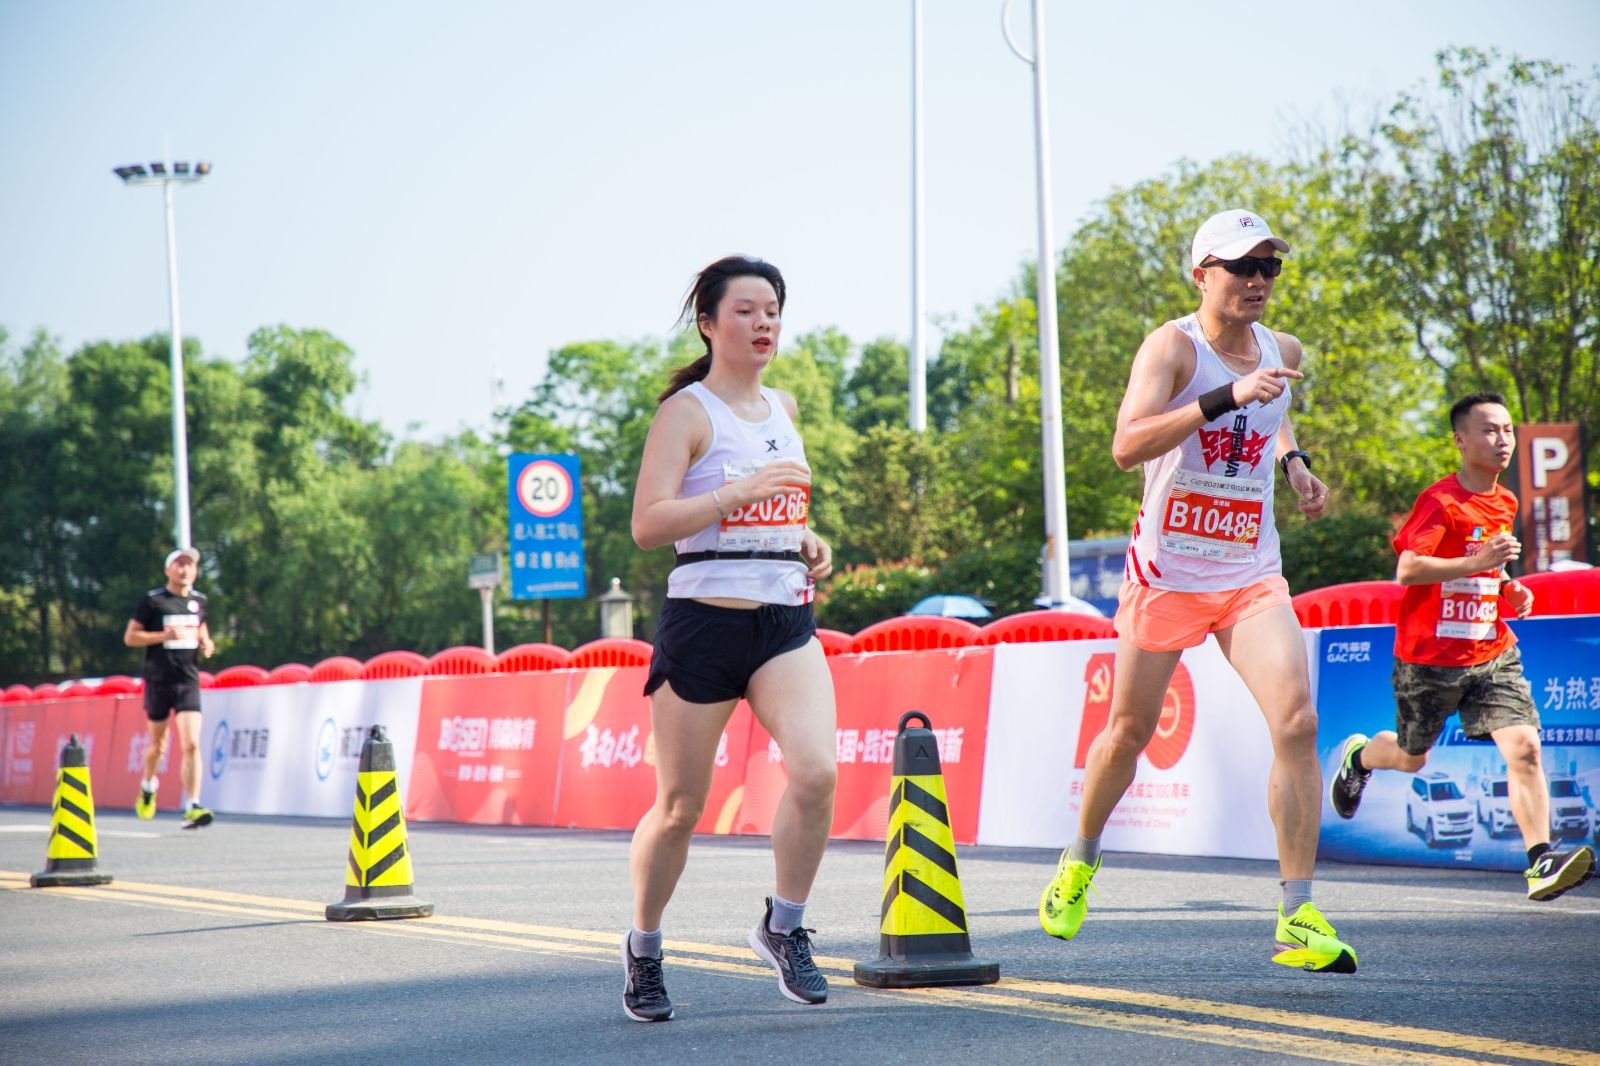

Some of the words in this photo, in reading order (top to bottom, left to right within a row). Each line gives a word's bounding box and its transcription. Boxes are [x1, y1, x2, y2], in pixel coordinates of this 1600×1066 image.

[1532, 437, 1568, 488] P
[532, 477, 559, 500] 20
[1168, 500, 1259, 539] B10485
[1327, 653, 1348, 663] GAC
[1349, 653, 1370, 663] FCA
